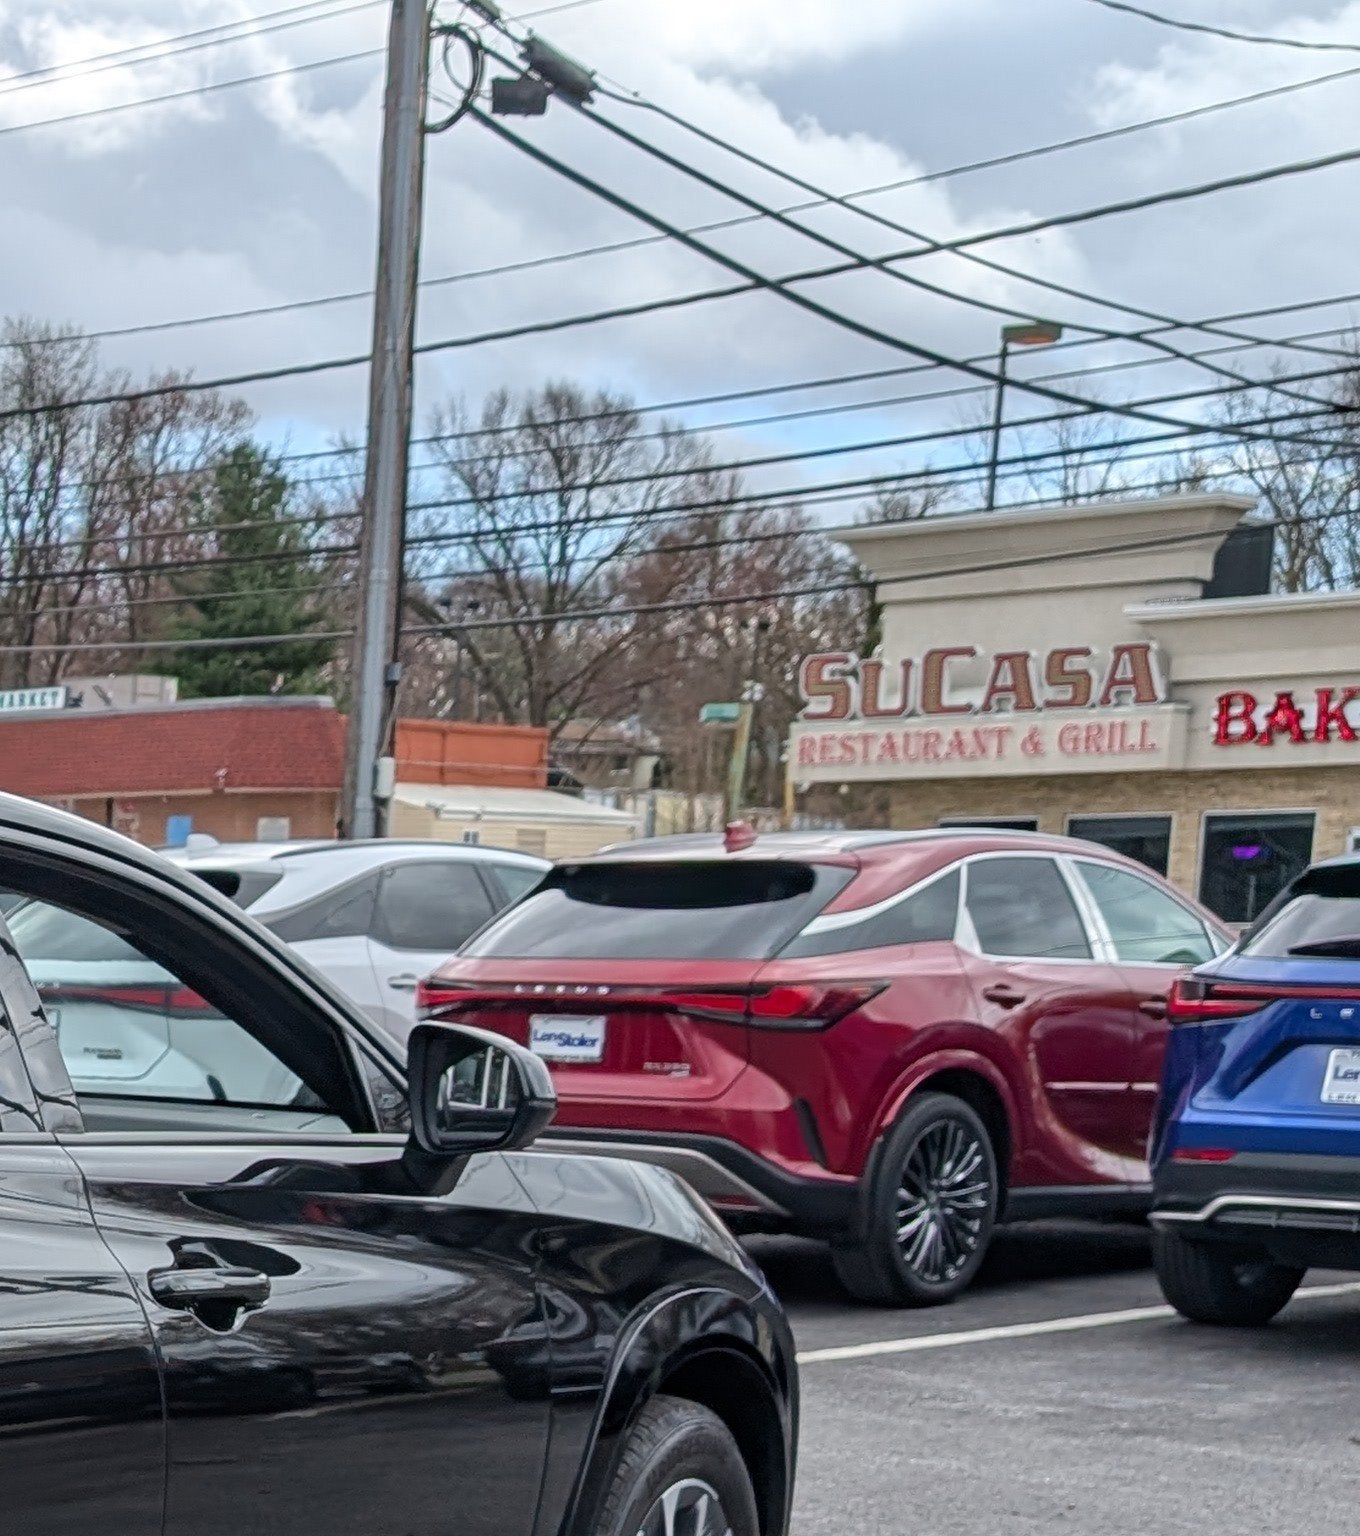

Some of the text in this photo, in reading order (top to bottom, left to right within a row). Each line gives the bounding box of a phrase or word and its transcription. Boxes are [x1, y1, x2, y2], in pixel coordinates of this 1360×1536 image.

[797, 719, 1160, 766] RESTAURANT & GRILL
[1212, 686, 1360, 746] BAK
